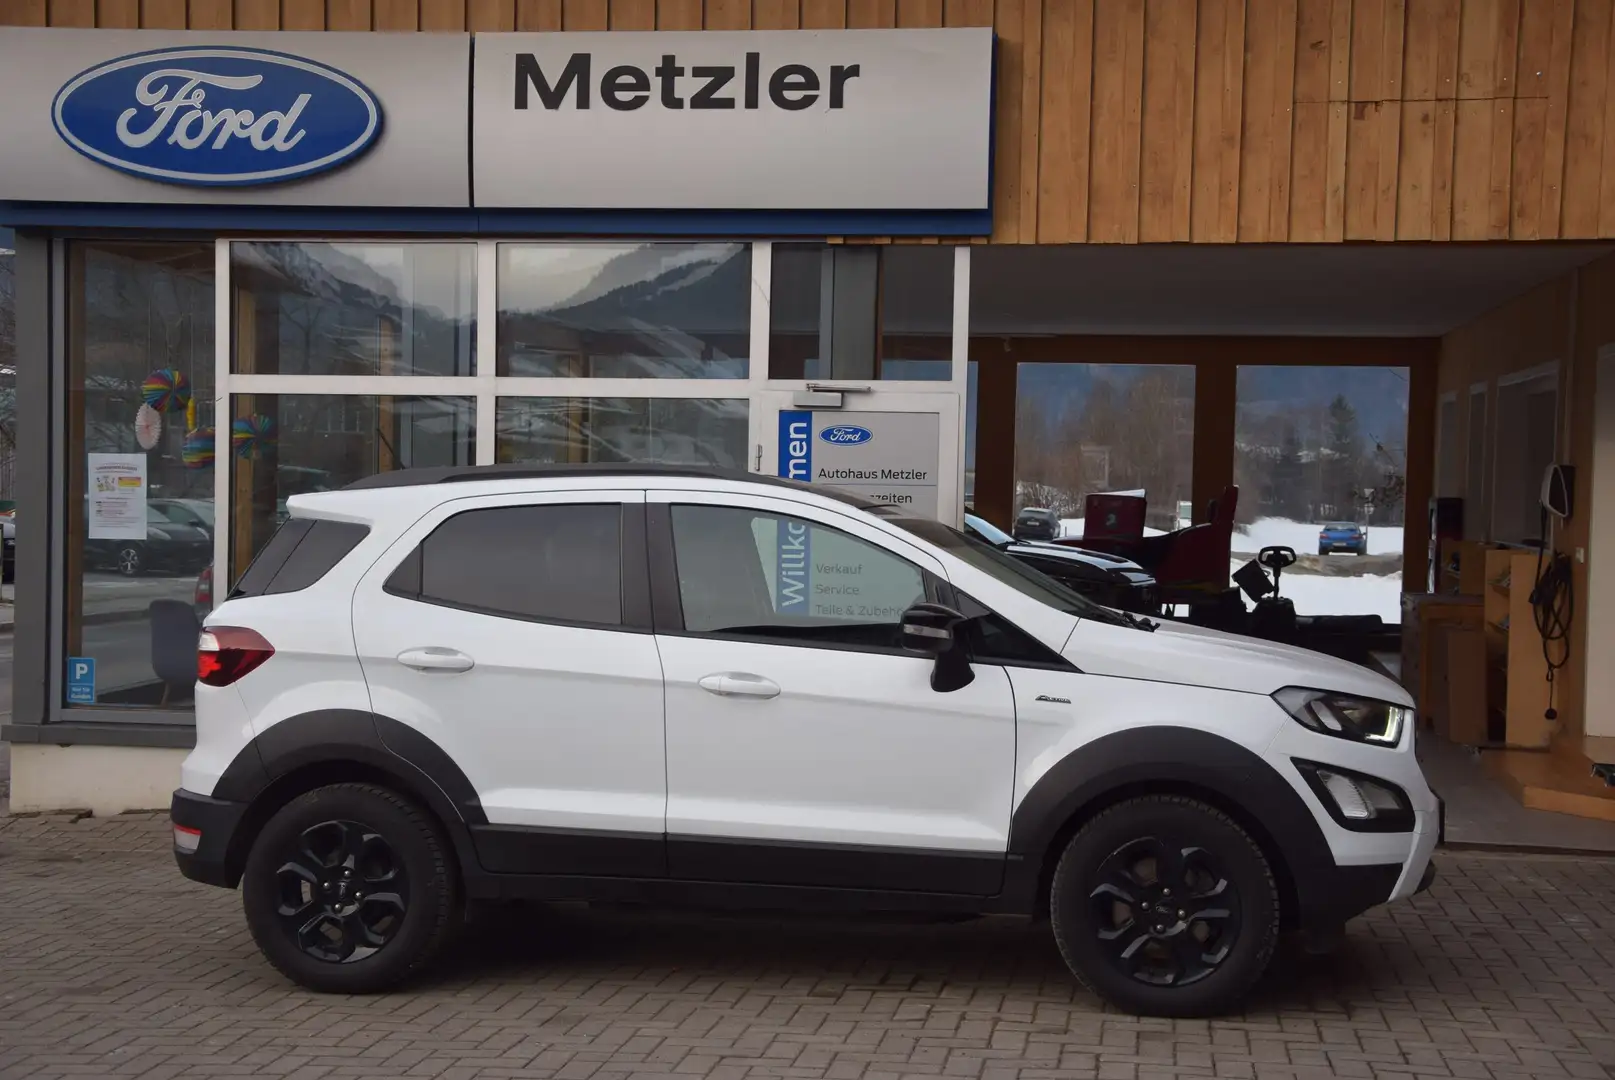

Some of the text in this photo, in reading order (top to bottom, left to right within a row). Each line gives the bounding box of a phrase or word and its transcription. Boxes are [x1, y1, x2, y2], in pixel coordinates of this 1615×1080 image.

[513, 52, 861, 111] Metzler
[115, 68, 312, 152] Ford
[829, 428, 862, 442] Ford
[818, 468, 928, 480] Autohaus Metzler
[815, 563, 862, 575] Verkauf
[815, 584, 860, 595] Service
[815, 604, 843, 616] Teile
[845, 605, 855, 616] &
[75, 663, 88, 680] P
